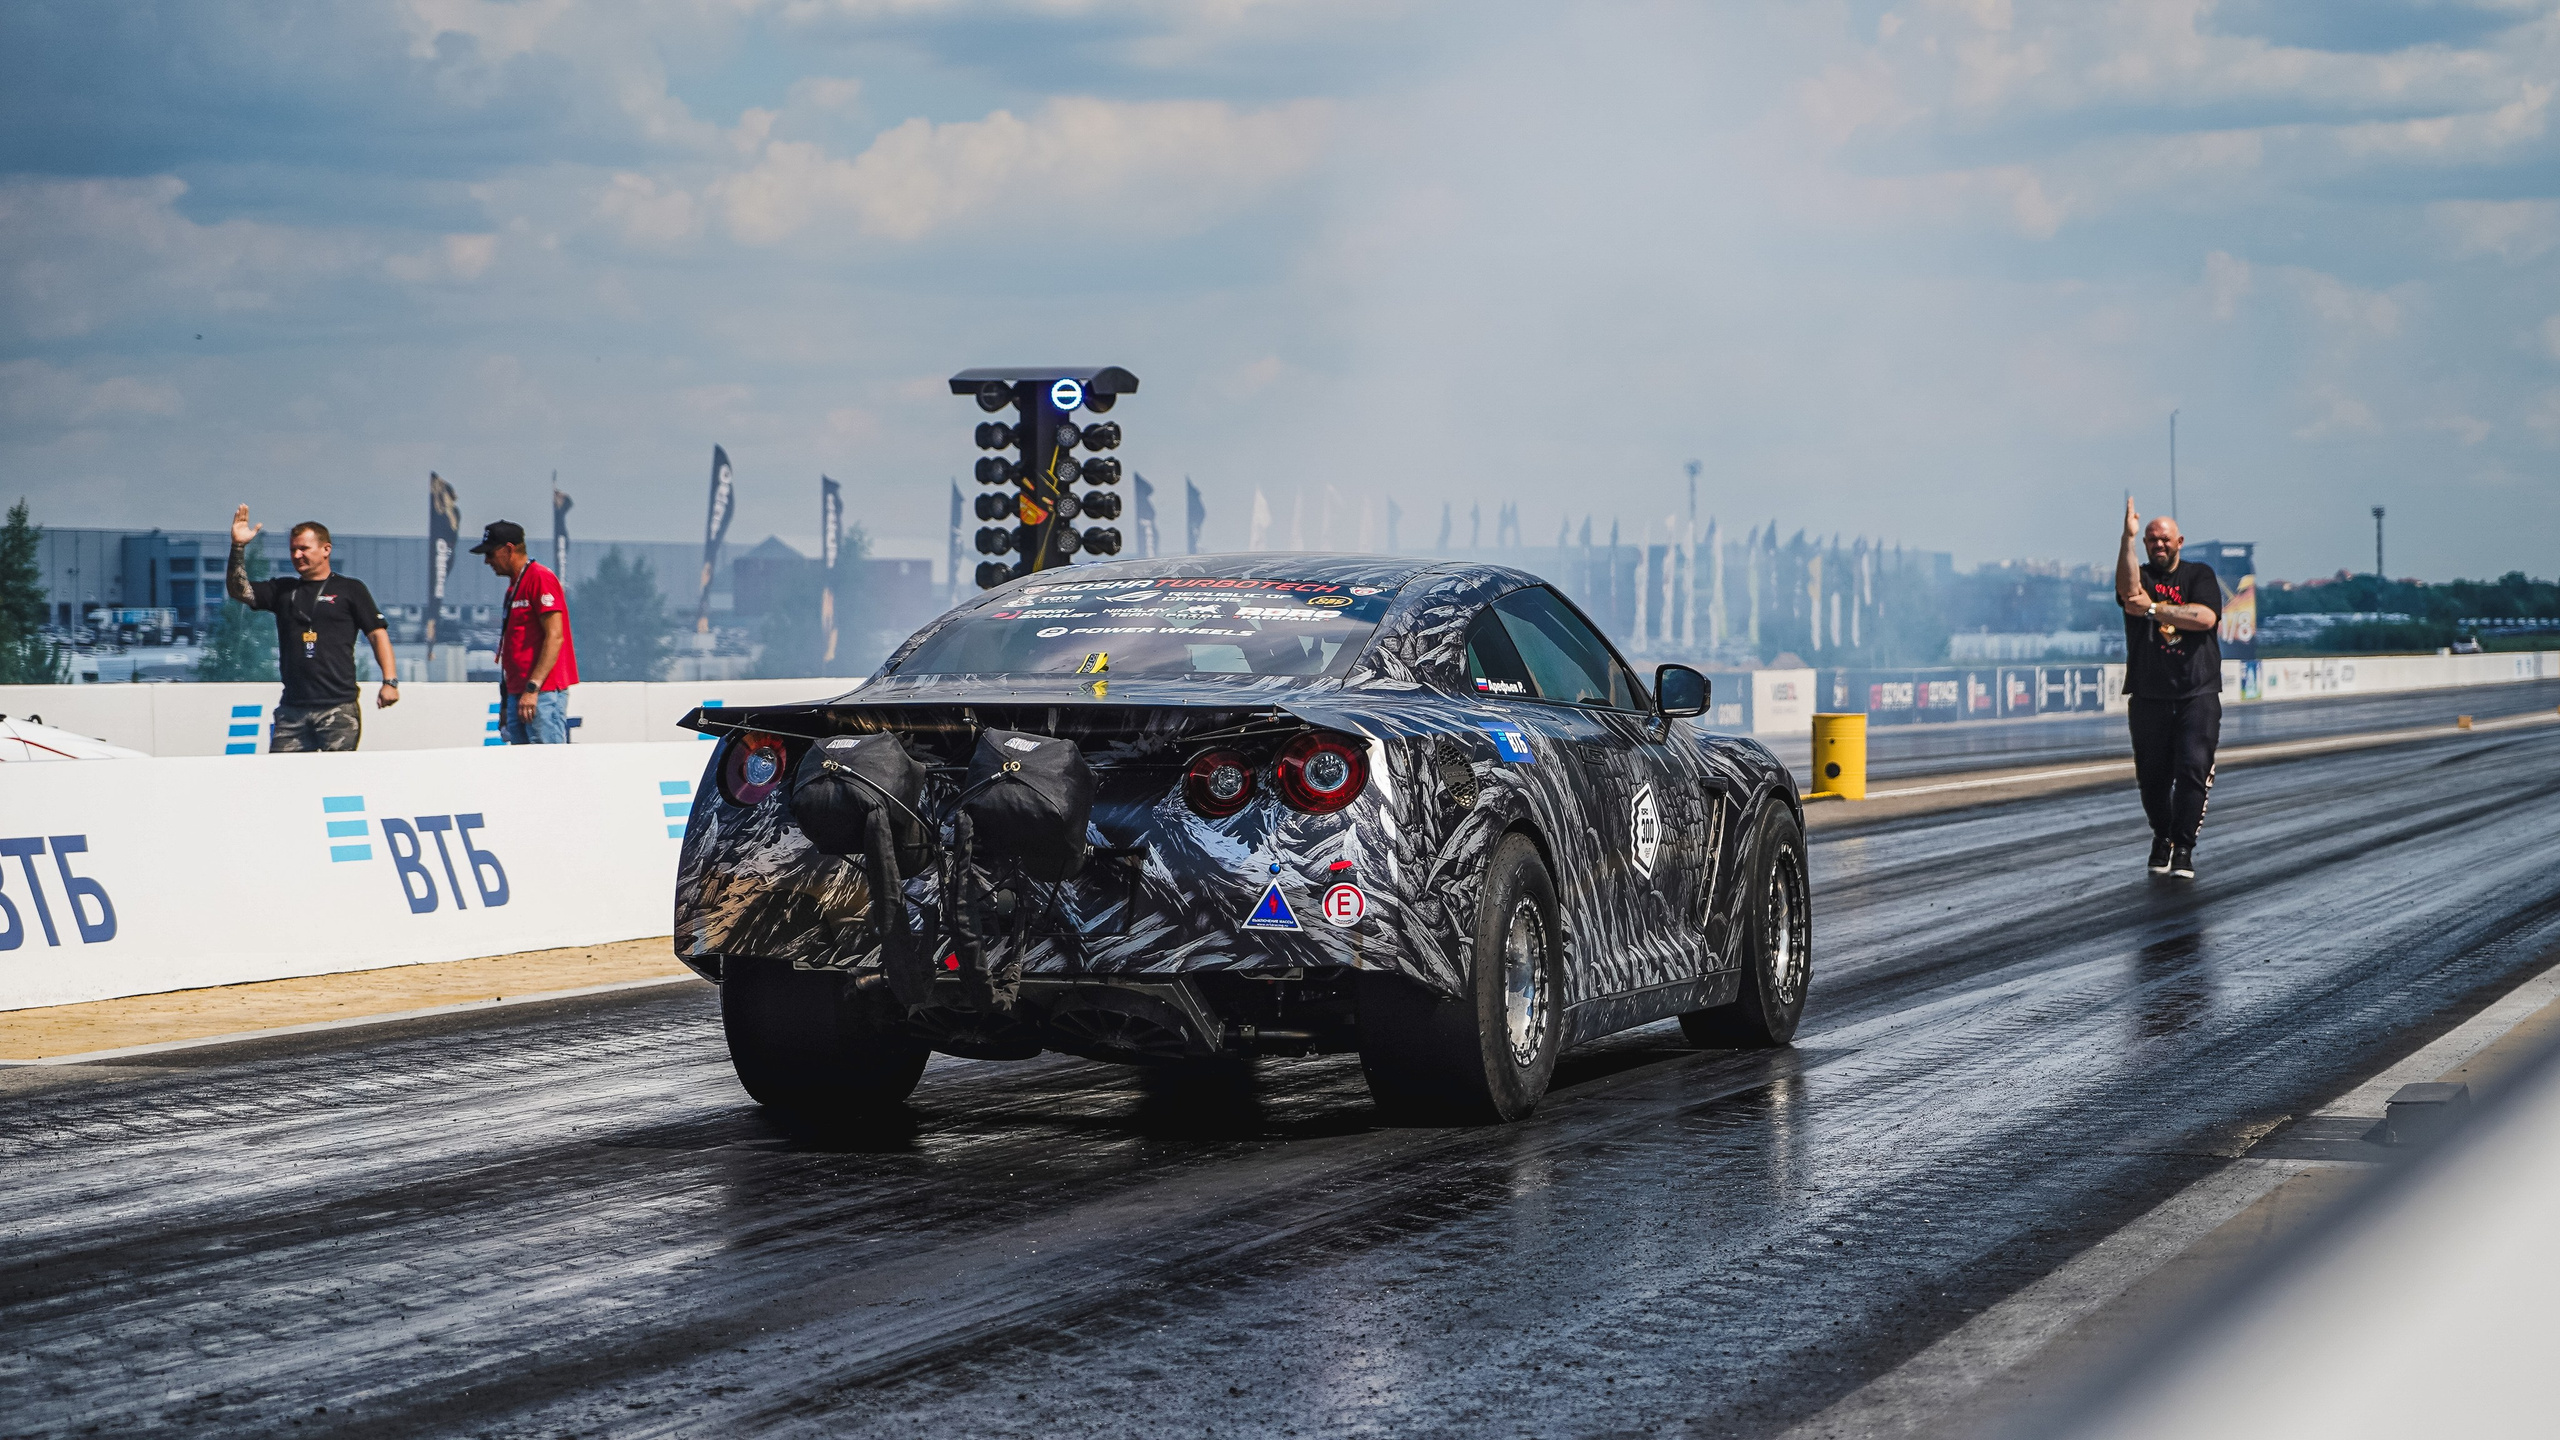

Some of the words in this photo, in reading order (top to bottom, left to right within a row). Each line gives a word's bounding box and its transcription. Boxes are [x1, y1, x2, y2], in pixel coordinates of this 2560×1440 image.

[1051, 580, 1154, 592] GOSHA
[1154, 579, 1341, 593] TURBOTECH
[1168, 591, 1263, 599] REPUBLIC
[1159, 627, 1256, 636] WHEELS
[1488, 679, 1519, 694] Арефьев
[1517, 681, 1527, 693] Р.
[1505, 732, 1528, 753] ВТБ
[1641, 818, 1654, 844] 300
[381, 812, 510, 914] ВТБ
[1337, 893, 1351, 916] E
